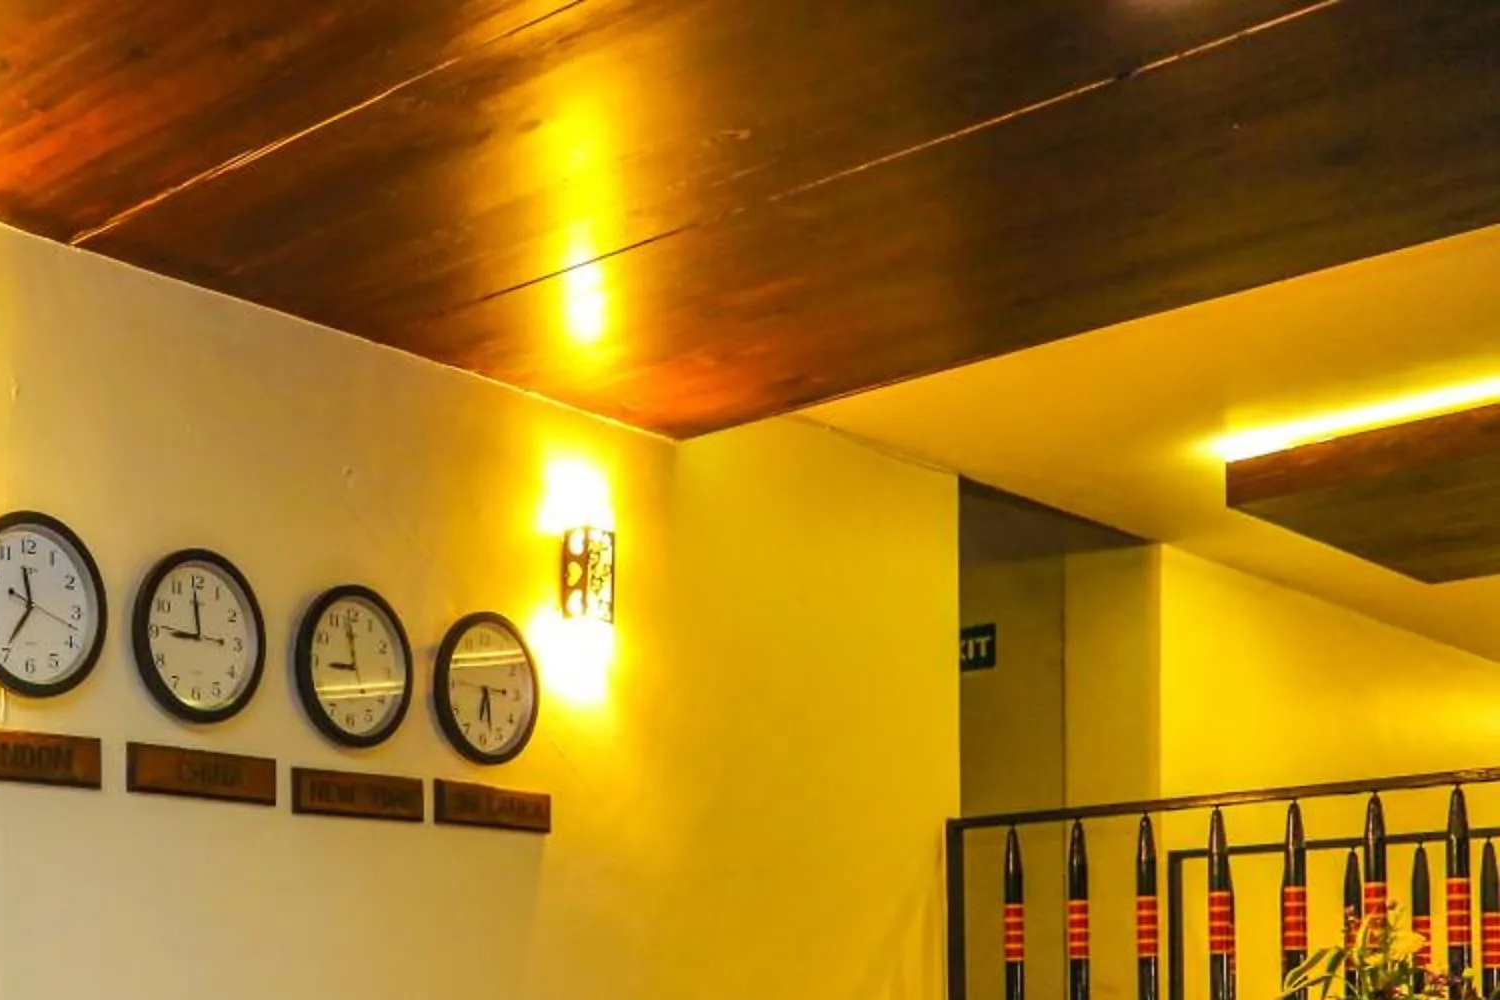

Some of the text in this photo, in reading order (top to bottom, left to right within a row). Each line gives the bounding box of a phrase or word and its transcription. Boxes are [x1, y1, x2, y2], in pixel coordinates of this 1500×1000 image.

[0, 546, 11, 560] 11
[21, 539, 37, 554] 12
[50, 551, 55, 566] 1
[65, 575, 75, 590] 2
[171, 580, 182, 594] 11
[191, 575, 205, 589] 12
[215, 587, 219, 601] 1
[71, 606, 81, 620] 3
[157, 599, 171, 613] 10
[227, 609, 237, 623] 2
[149, 625, 159, 638] 9
[65, 635, 74, 648] 4
[233, 638, 243, 652] 3
[1, 648, 11, 663] 7
[49, 653, 59, 668] 5
[155, 653, 165, 666] 8
[25, 658, 36, 674] 6
[225, 665, 235, 679] 4
[171, 675, 180, 689] 7
[211, 681, 220, 697] 5
[191, 686, 200, 700] 6
